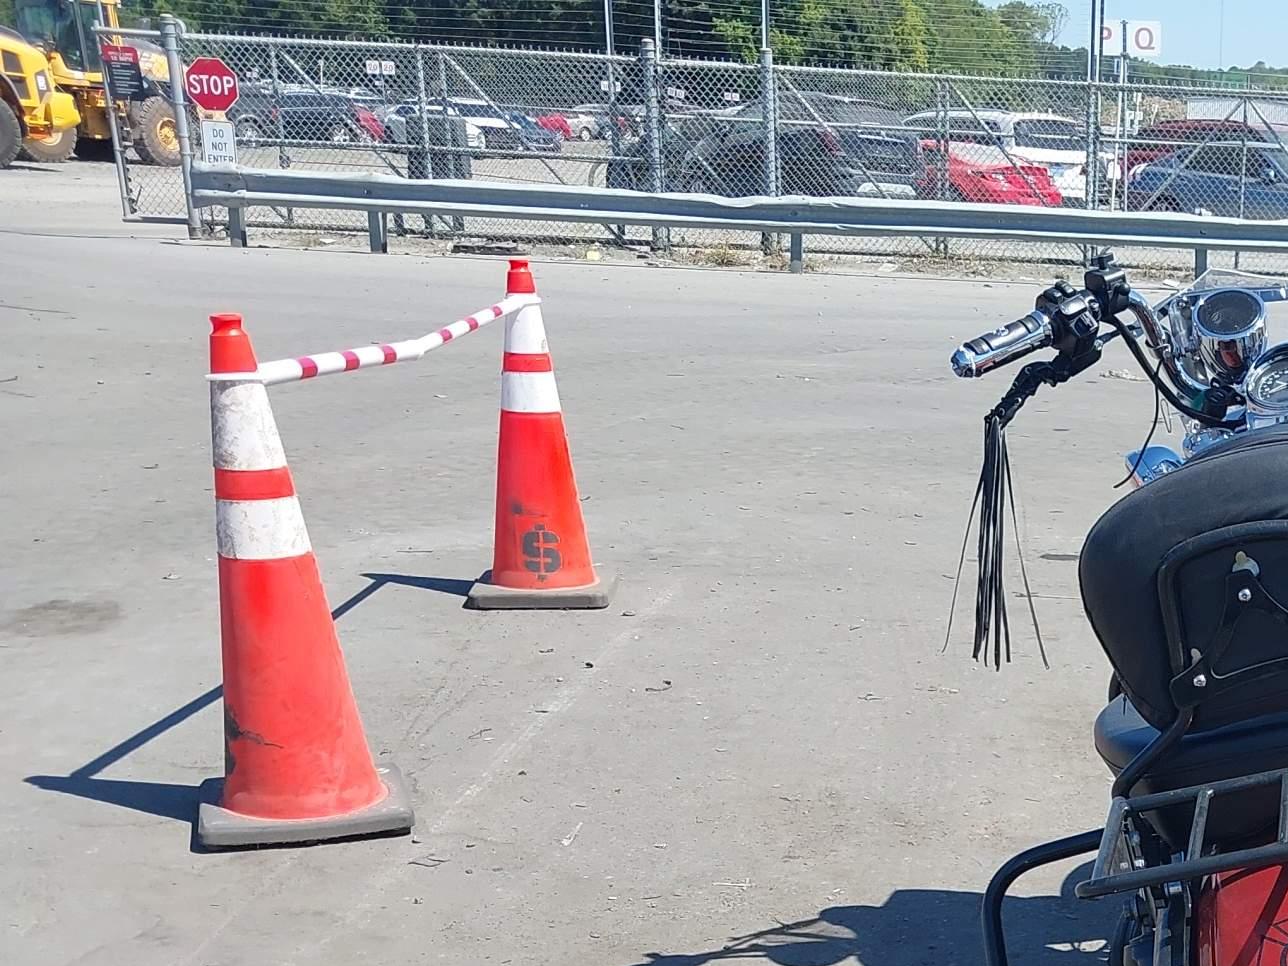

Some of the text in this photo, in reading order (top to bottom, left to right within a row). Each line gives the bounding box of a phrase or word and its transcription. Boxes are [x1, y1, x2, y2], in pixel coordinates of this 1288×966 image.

[1134, 27, 1156, 50] Q
[189, 74, 234, 95] STOP
[212, 128, 225, 138] DO
[211, 142, 228, 151] NOT
[207, 154, 234, 163] ENTER
